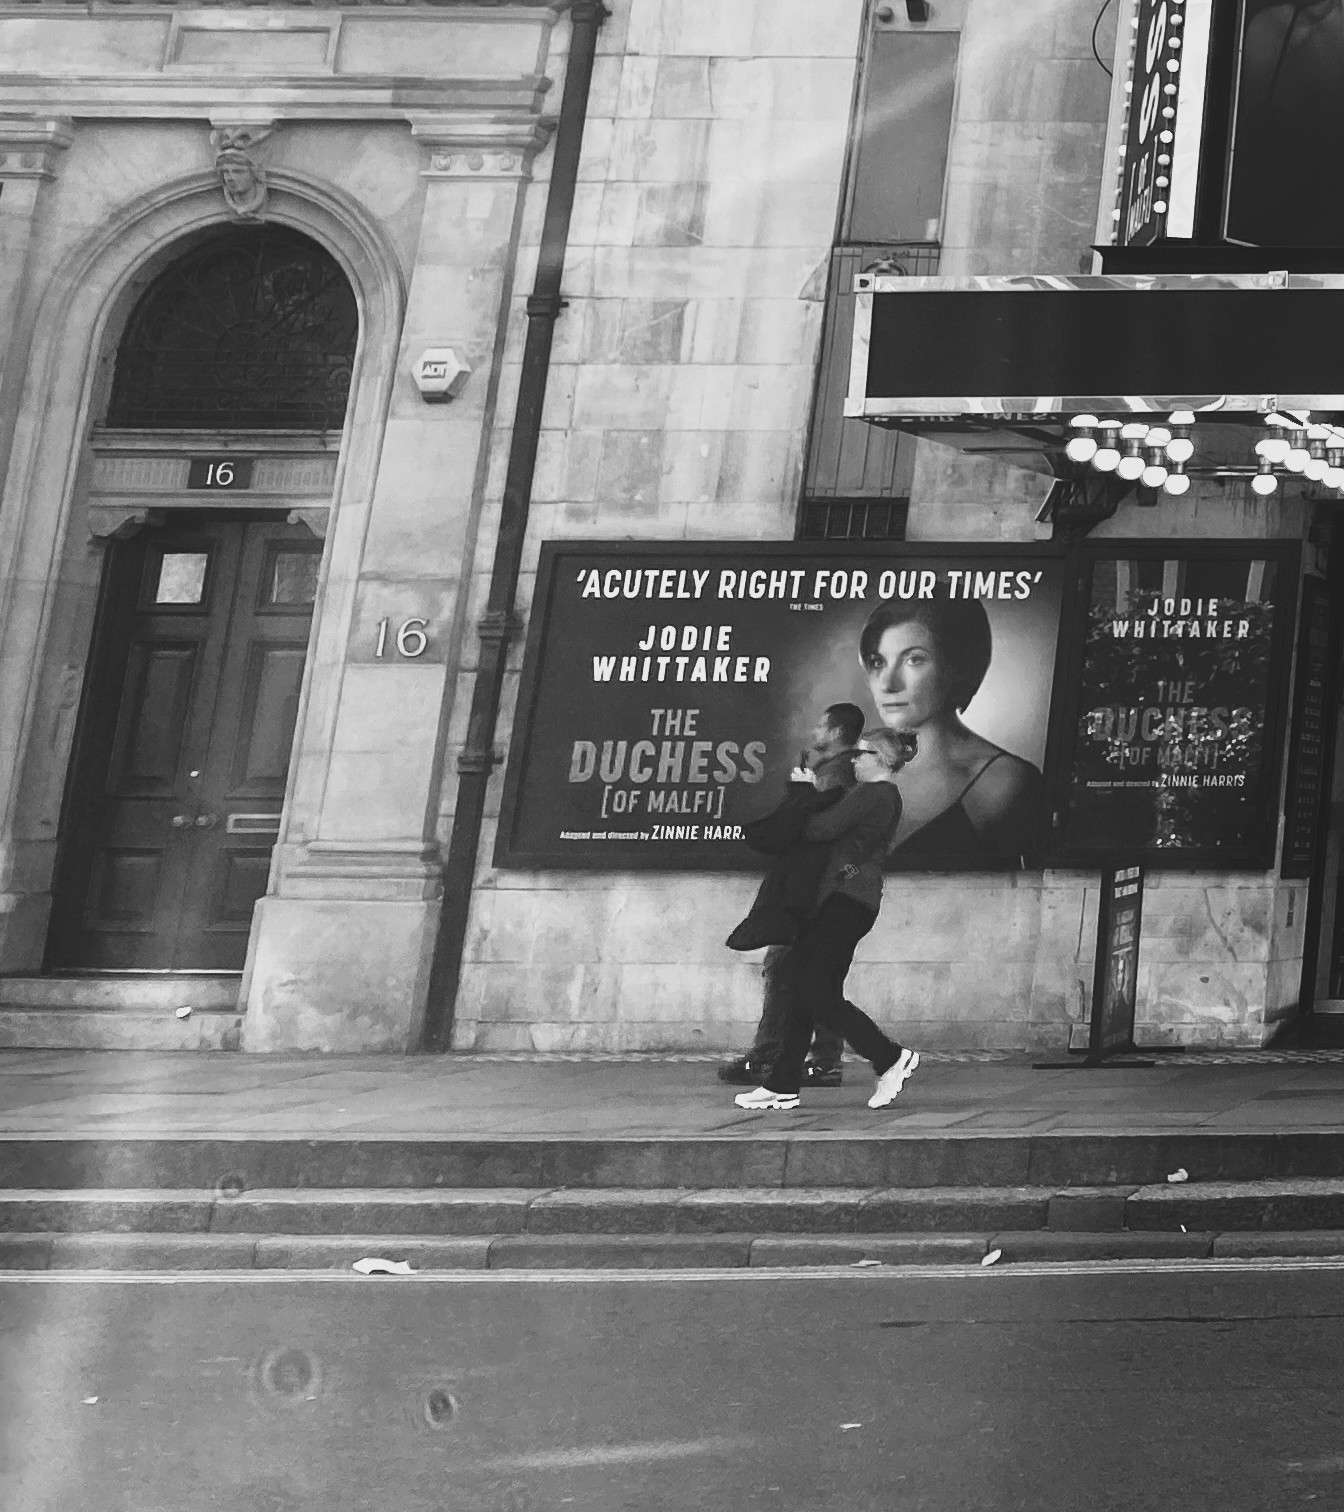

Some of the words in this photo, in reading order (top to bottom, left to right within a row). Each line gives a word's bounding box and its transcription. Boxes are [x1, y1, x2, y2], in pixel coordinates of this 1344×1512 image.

[422, 361, 447, 378] ADT
[205, 461, 235, 486] 16
[576, 569, 710, 599] 'ACUTELY
[717, 569, 805, 599] RIGHT
[813, 570, 869, 599] FOR
[878, 570, 935, 599] OUR
[946, 570, 1043, 600] TIMES'
[1148, 598, 1219, 617] JODIE
[374, 617, 429, 658] 16
[638, 625, 733, 651] JODIE
[1113, 620, 1250, 639] WHITTAKER
[592, 655, 771, 683] WHITTAKER
[1157, 680, 1196, 704] THE
[649, 708, 698, 736] THE
[1092, 707, 1252, 742] DUCHESS
[568, 740, 767, 784] DUCHESS
[1160, 774, 1200, 788] ZINNIE
[1203, 774, 1245, 787] HARRIS
[651, 825, 699, 841] ZINNIE
[704, 826, 746, 841] HARR
